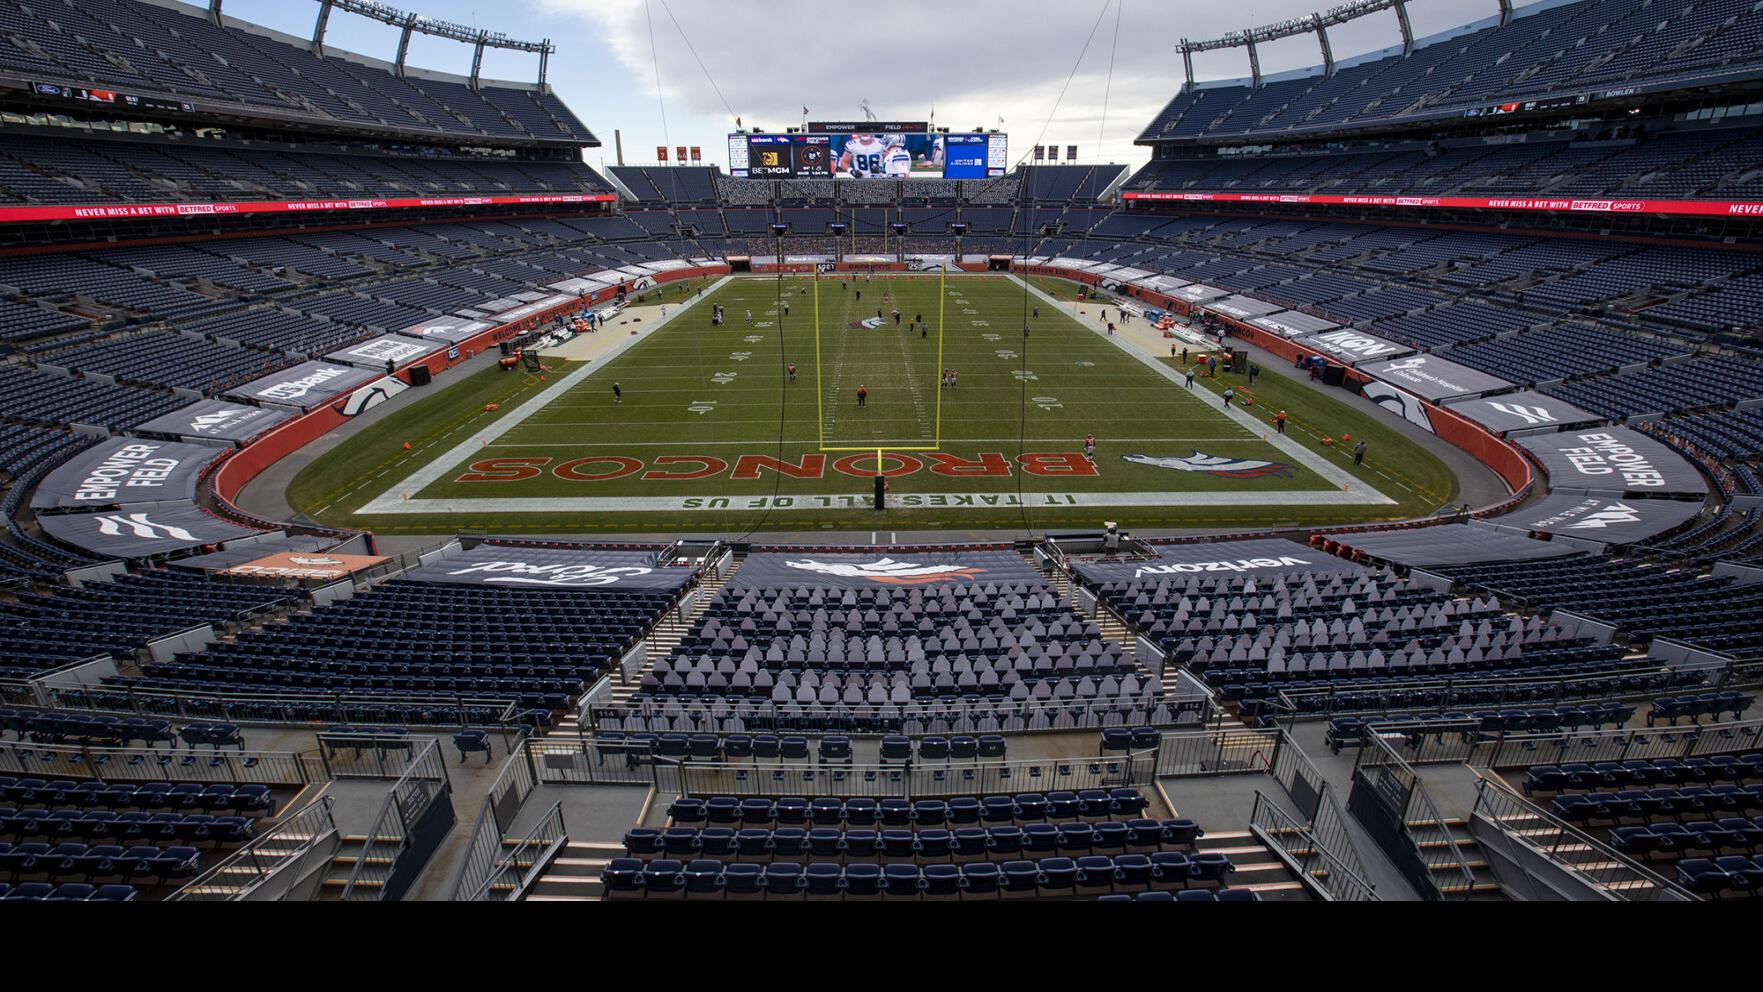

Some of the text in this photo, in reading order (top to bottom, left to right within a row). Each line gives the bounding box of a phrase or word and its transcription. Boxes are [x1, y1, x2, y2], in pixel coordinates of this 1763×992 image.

[1606, 88, 1634, 98] BOWLEN
[1320, 332, 1398, 356] IKON
[74, 444, 160, 500] EMPOWER
[126, 458, 180, 486] FIELD
[454, 452, 1100, 482] BRONCOS
[1558, 447, 1614, 474] FIELD
[1577, 433, 1666, 486] EMPOWER
[682, 494, 1076, 508] IT TAKES ALL OF US
[448, 562, 652, 586] Ford
[1135, 556, 1312, 578] verizon
